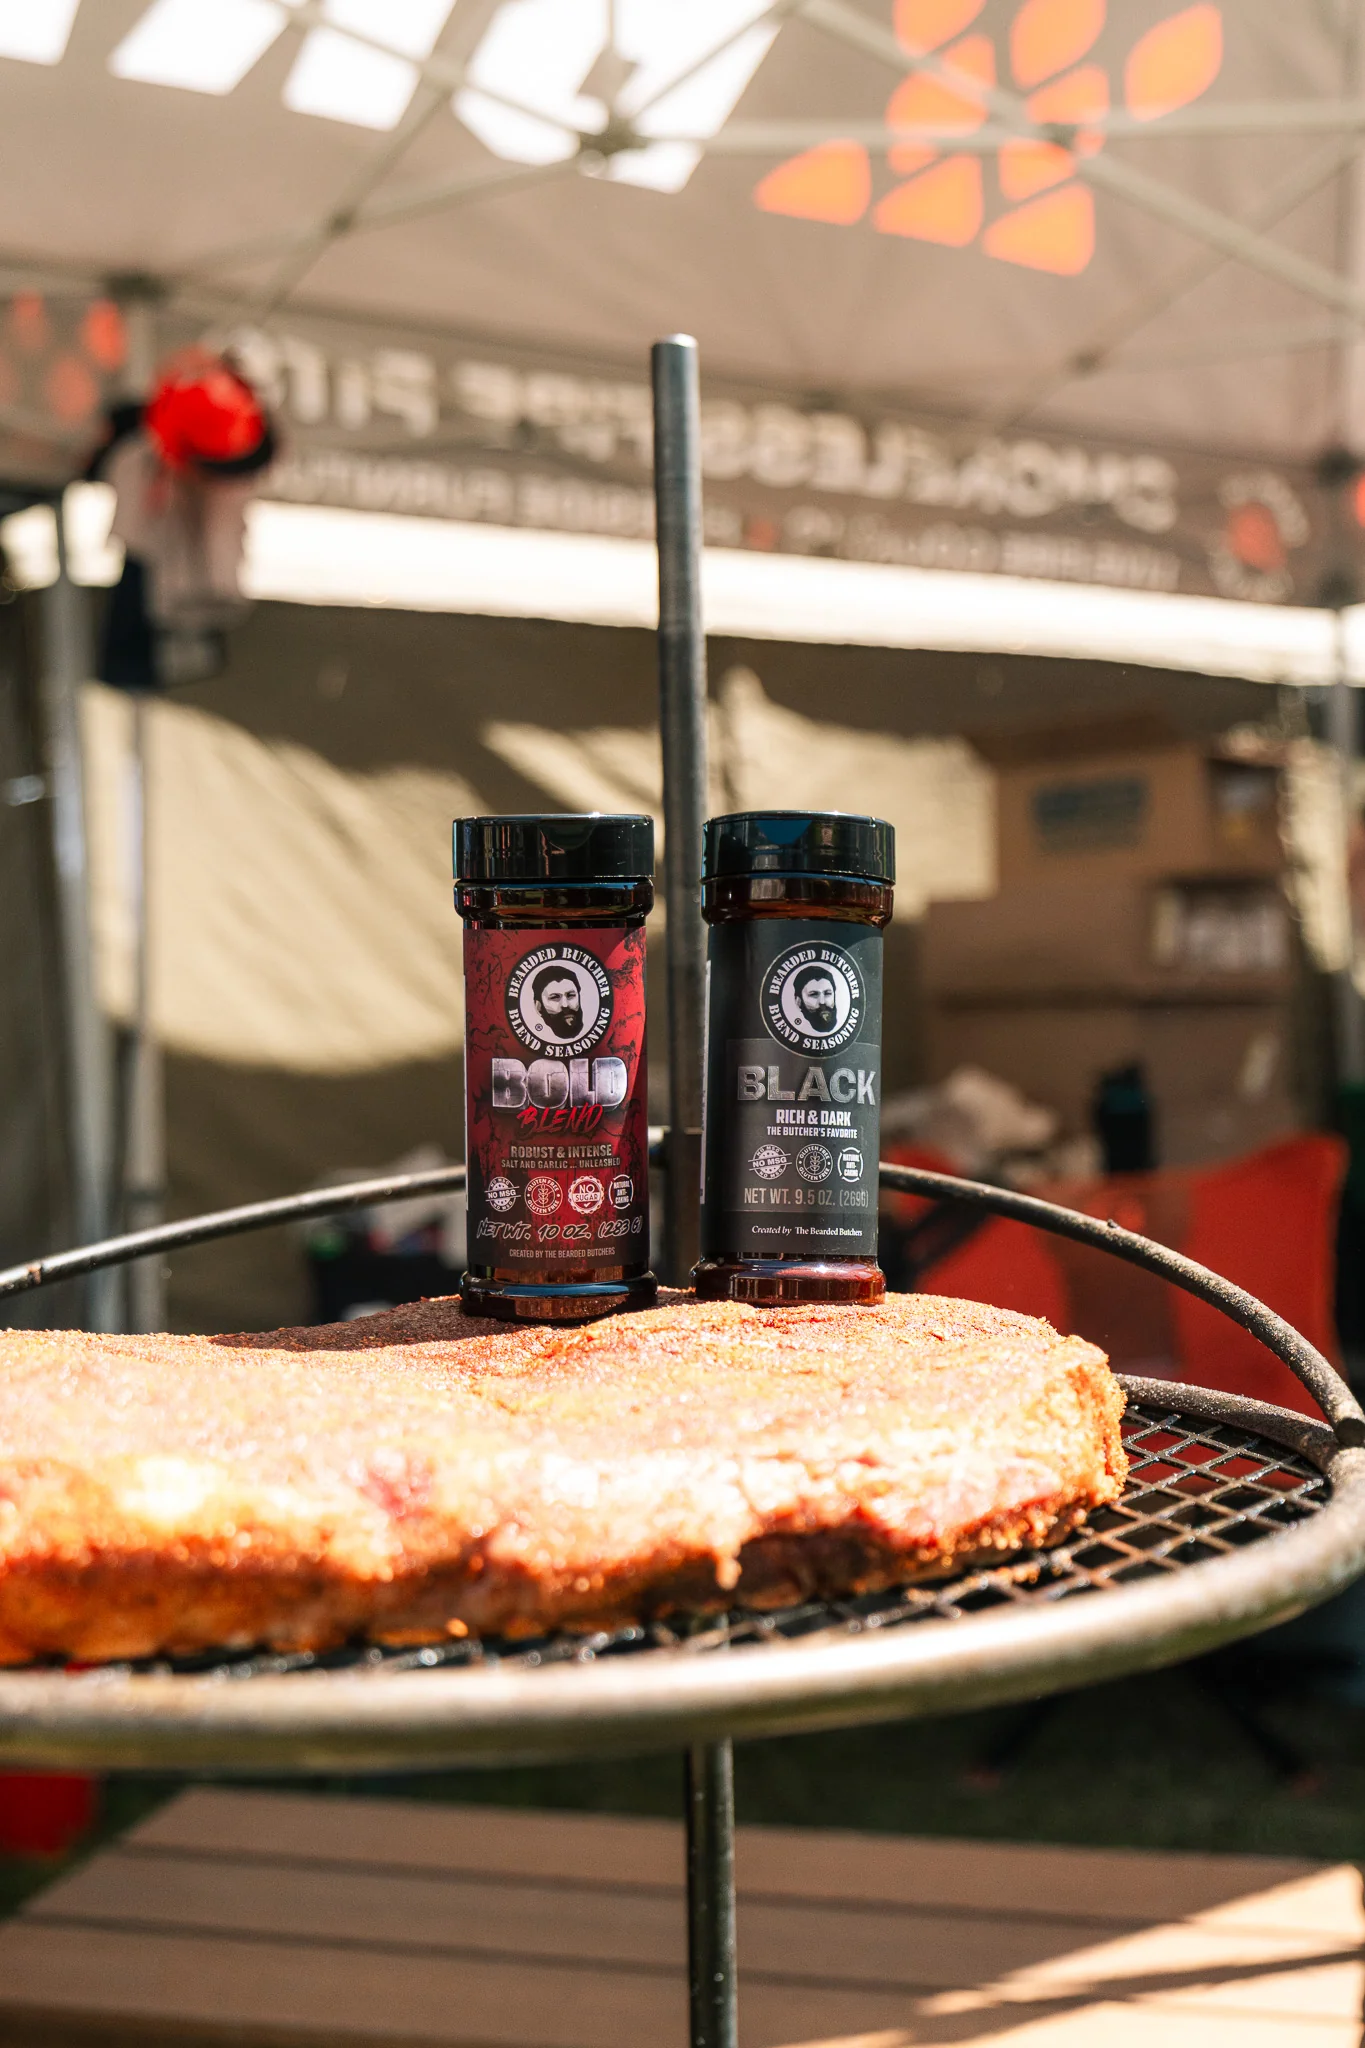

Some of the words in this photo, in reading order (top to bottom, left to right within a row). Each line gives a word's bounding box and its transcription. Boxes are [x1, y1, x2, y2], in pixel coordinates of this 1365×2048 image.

[509, 948, 557, 998] BEARDED
[562, 947, 611, 998] BUTCHER
[769, 949, 817, 996] BEARDED
[821, 949, 860, 999] BUTCHER
[508, 1008, 541, 1051] BLEND
[545, 1007, 611, 1057] SEASONING
[768, 1004, 800, 1043] BLEND
[802, 1008, 860, 1050] SEASONING
[492, 1057, 628, 1109] BOLD
[738, 1065, 876, 1106] BLACK
[516, 1103, 603, 1136] BLEND
[776, 1109, 805, 1124] RICH
[807, 1110, 818, 1125] &
[821, 1111, 851, 1126] DARK
[767, 1126, 782, 1136] THE
[783, 1126, 826, 1138] BUTCHER'S
[826, 1128, 857, 1139] FAVORITE
[511, 1145, 555, 1159] ROBUST
[556, 1147, 566, 1158] &
[568, 1144, 612, 1158] INTENSE
[800, 1145, 819, 1159] GLUTEN
[819, 1147, 830, 1159] FREE
[501, 1159, 520, 1169] SALT
[520, 1161, 536, 1169] AND
[538, 1160, 568, 1169] GARLIC
[579, 1157, 621, 1168] UNLEASHED
[752, 1159, 765, 1168] NO
[767, 1156, 787, 1166] MSG
[799, 1168, 819, 1180] GLUTEN
[819, 1168, 830, 1180] FREE
[527, 1179, 546, 1192] GLUTEN
[546, 1179, 559, 1192] FREE
[579, 1184, 595, 1193] NO
[488, 1191, 498, 1199] NO
[575, 1193, 598, 1201] SUGAR
[744, 1188, 766, 1204] NET
[770, 1189, 791, 1205] WT.
[795, 1189, 815, 1205] 9.5
[819, 1190, 836, 1206] OZ.
[839, 1190, 869, 1208] (269G)
[527, 1200, 548, 1213] GLUTEN
[548, 1200, 559, 1212] FREE
[477, 1217, 503, 1239] NET
[502, 1220, 531, 1240] WT.
[538, 1223, 560, 1242] 10
[562, 1223, 592, 1240] OZ.
[752, 1226, 781, 1235] Created
[782, 1226, 792, 1236] by
[795, 1227, 809, 1235] The
[810, 1227, 838, 1236] Bearded
[839, 1228, 862, 1237] Butchers
[509, 1249, 534, 1258] CREATED
[535, 1250, 544, 1258] BY
[545, 1250, 557, 1258] THE
[558, 1249, 586, 1258] BEARDED
[587, 1247, 616, 1258] BUTCHERS
